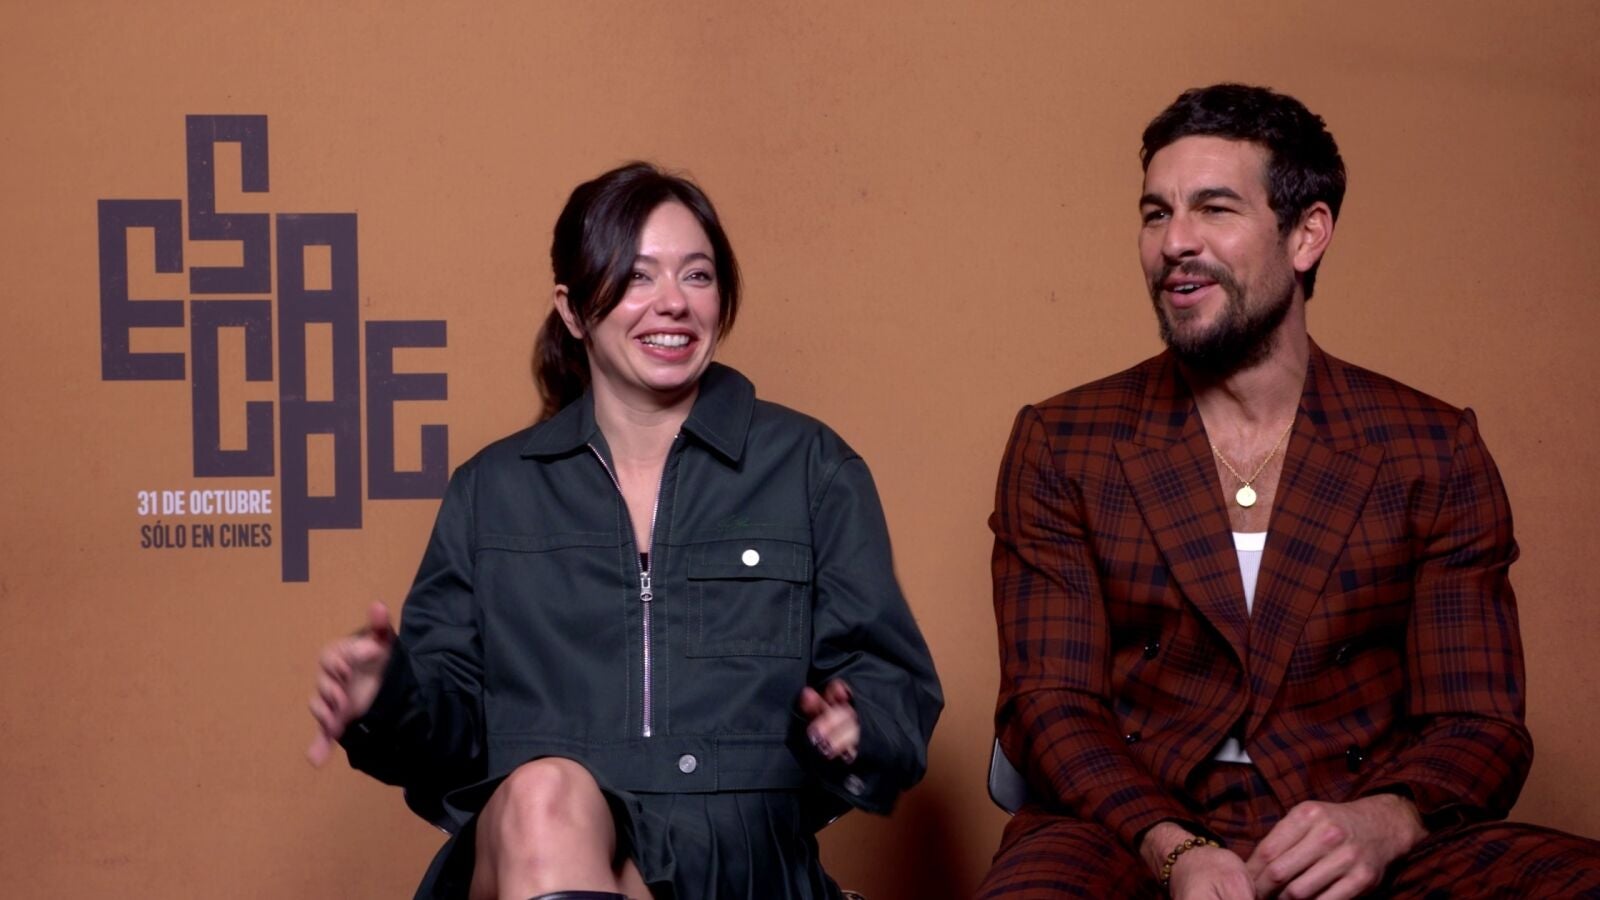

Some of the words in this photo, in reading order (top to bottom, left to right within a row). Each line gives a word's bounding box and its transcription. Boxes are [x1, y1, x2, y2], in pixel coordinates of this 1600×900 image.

[98, 114, 449, 583] ESCAPE
[137, 490, 158, 515] 31
[162, 490, 186, 515] DE
[189, 489, 273, 515] OCTUBRE
[140, 519, 187, 549] SÓLO
[191, 524, 214, 548] EN
[219, 523, 272, 548] CINES
